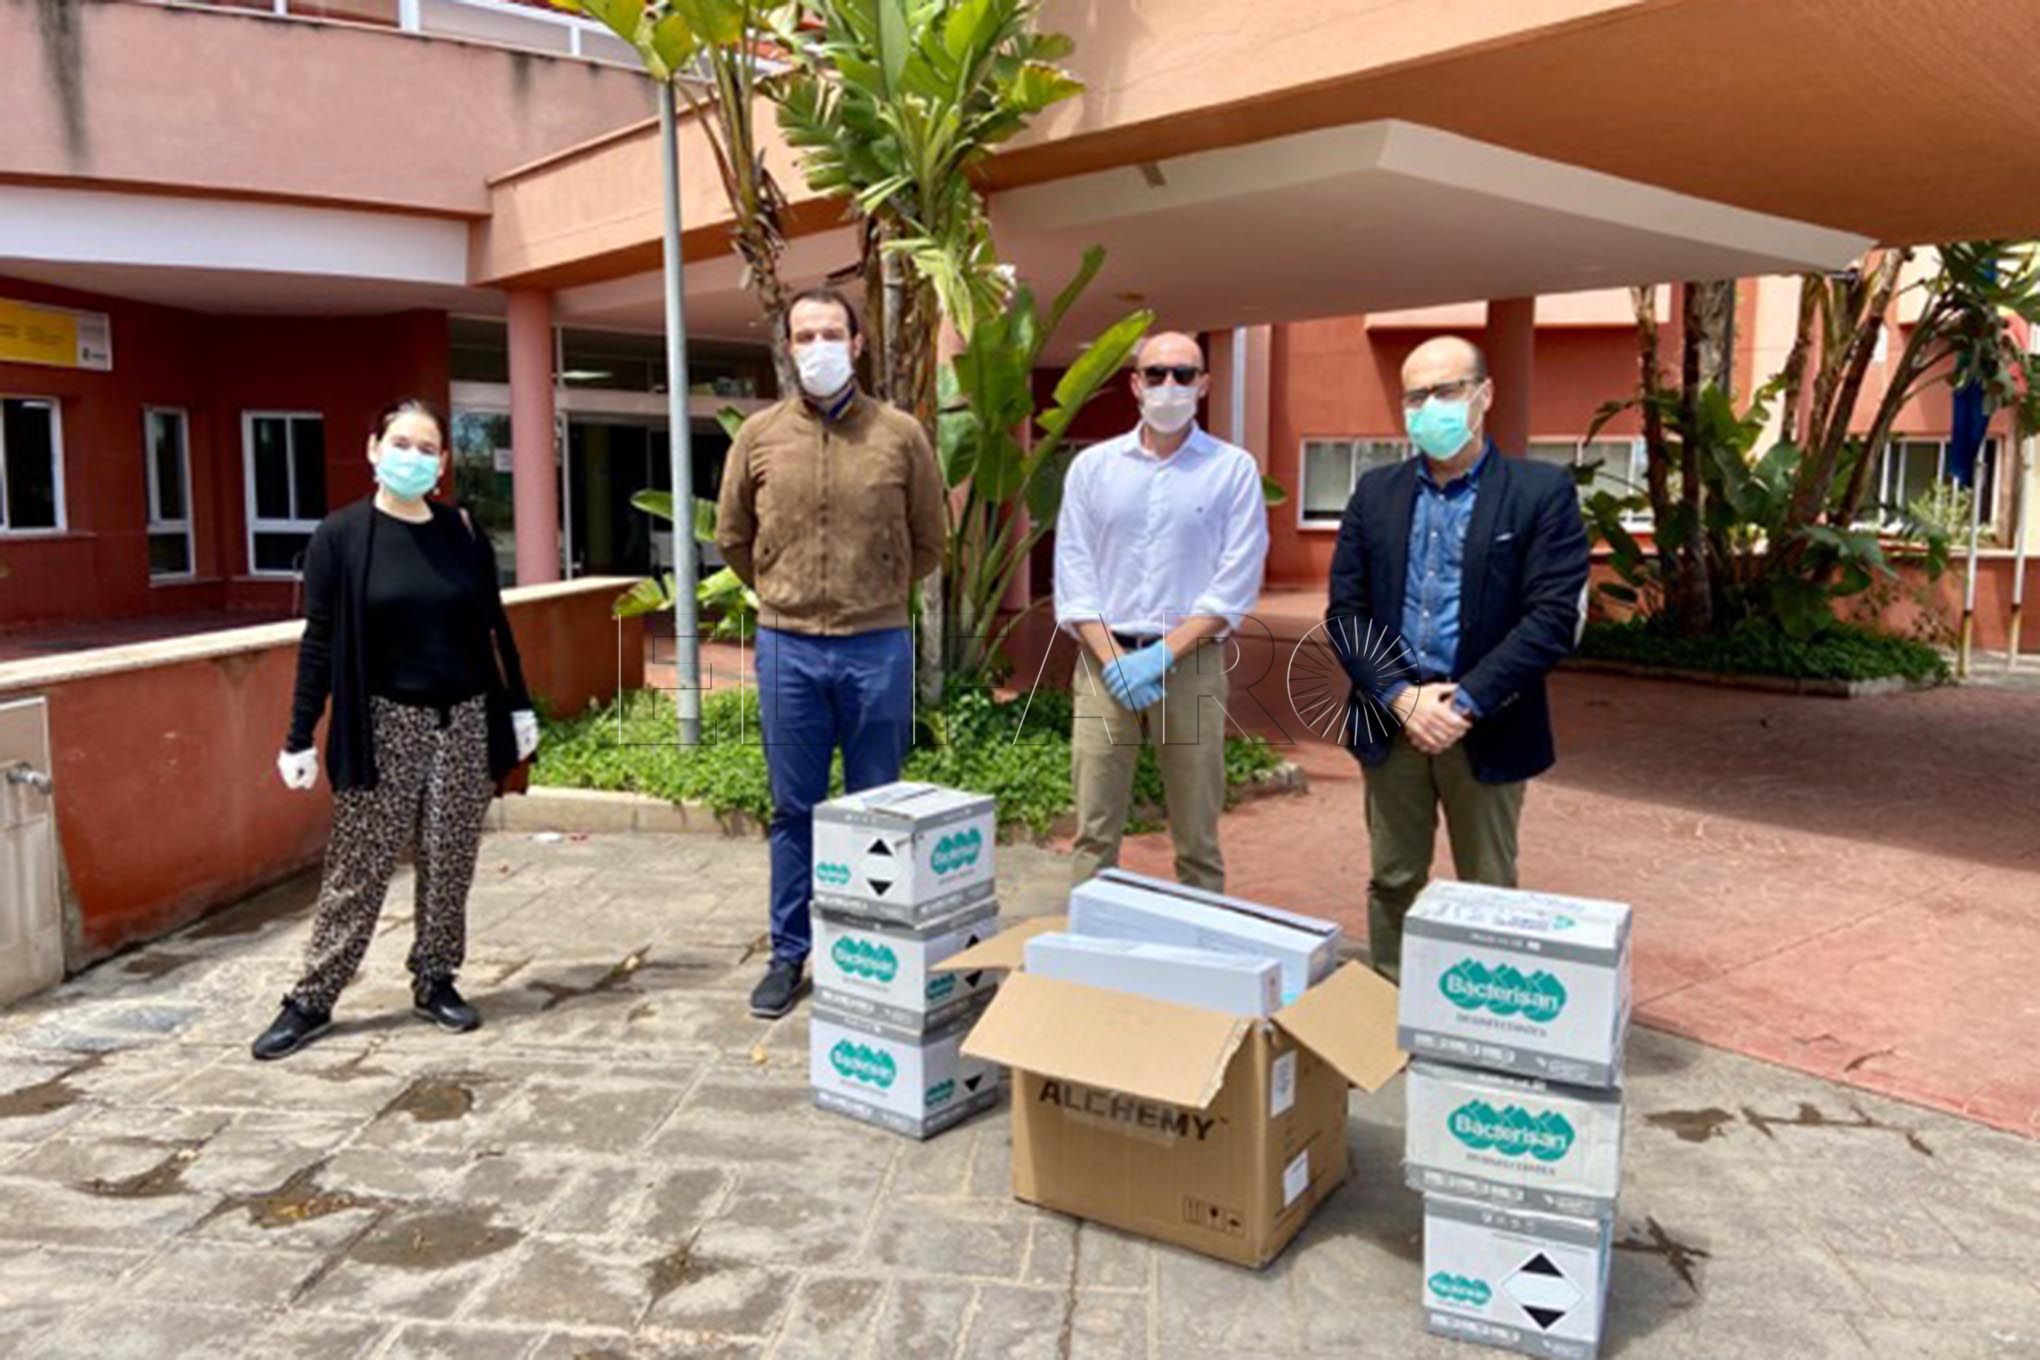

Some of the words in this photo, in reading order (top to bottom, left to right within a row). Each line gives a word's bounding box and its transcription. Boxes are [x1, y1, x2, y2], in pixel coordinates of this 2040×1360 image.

[1446, 972, 1559, 1011] Bacterisan
[1038, 1078, 1215, 1142] ALCHEMY
[1454, 1113, 1568, 1150] Bacterisan
